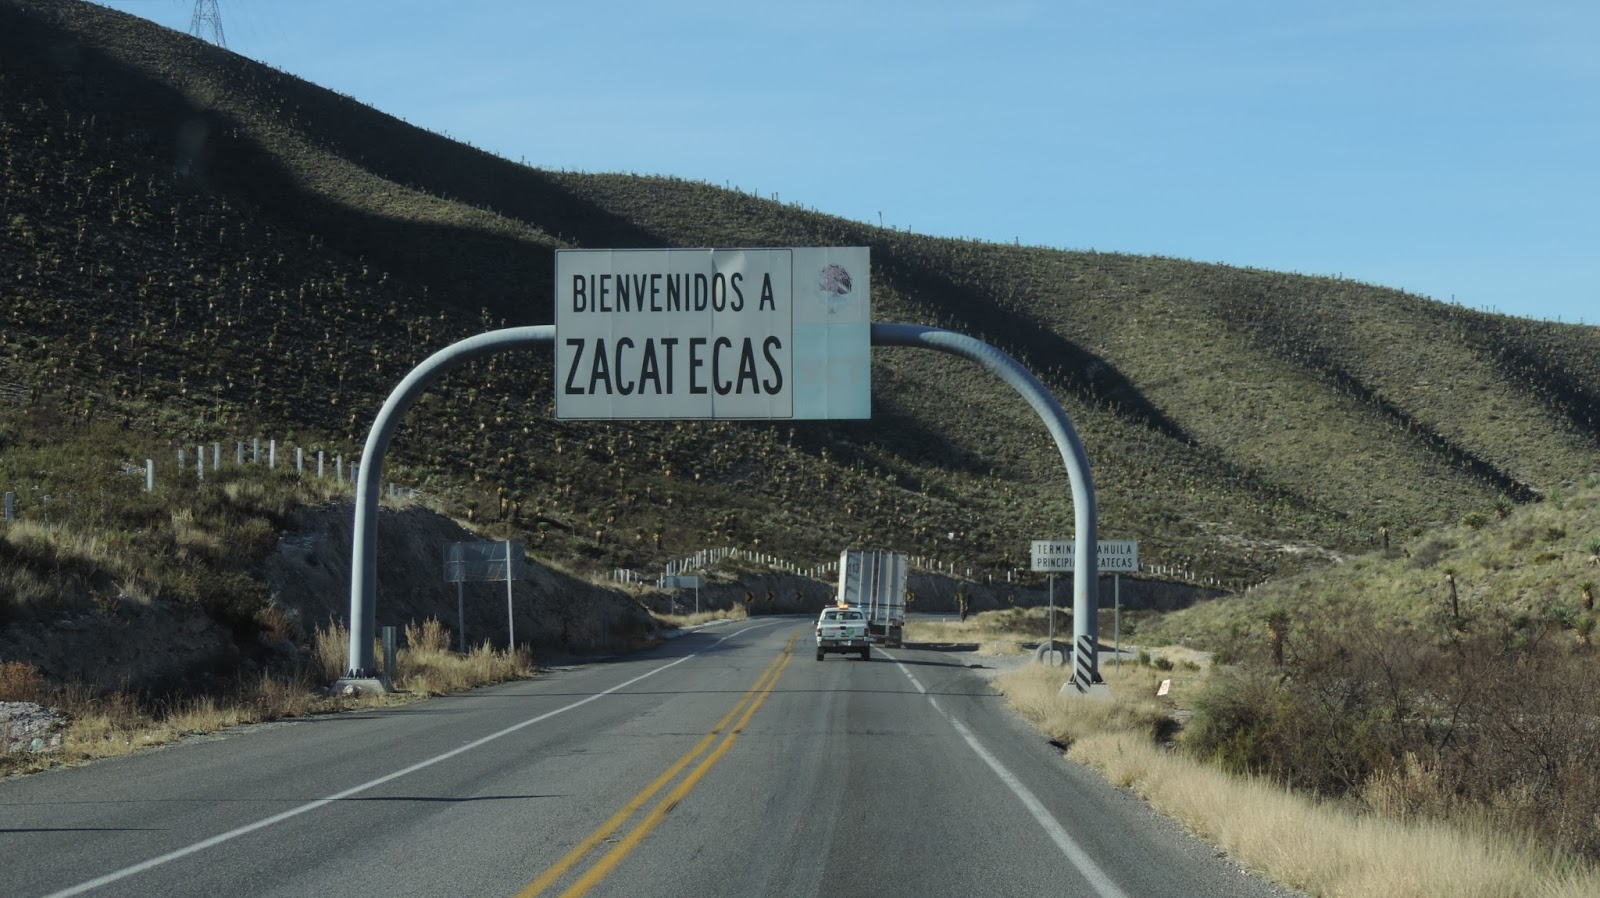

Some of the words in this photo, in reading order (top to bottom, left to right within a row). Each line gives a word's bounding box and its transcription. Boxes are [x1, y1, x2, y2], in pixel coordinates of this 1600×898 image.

[573, 272, 745, 313] BIENVENIDOS
[759, 272, 776, 311] A
[565, 335, 783, 396] ZACATECAS
[1037, 558, 1075, 568] PRINCIPI
